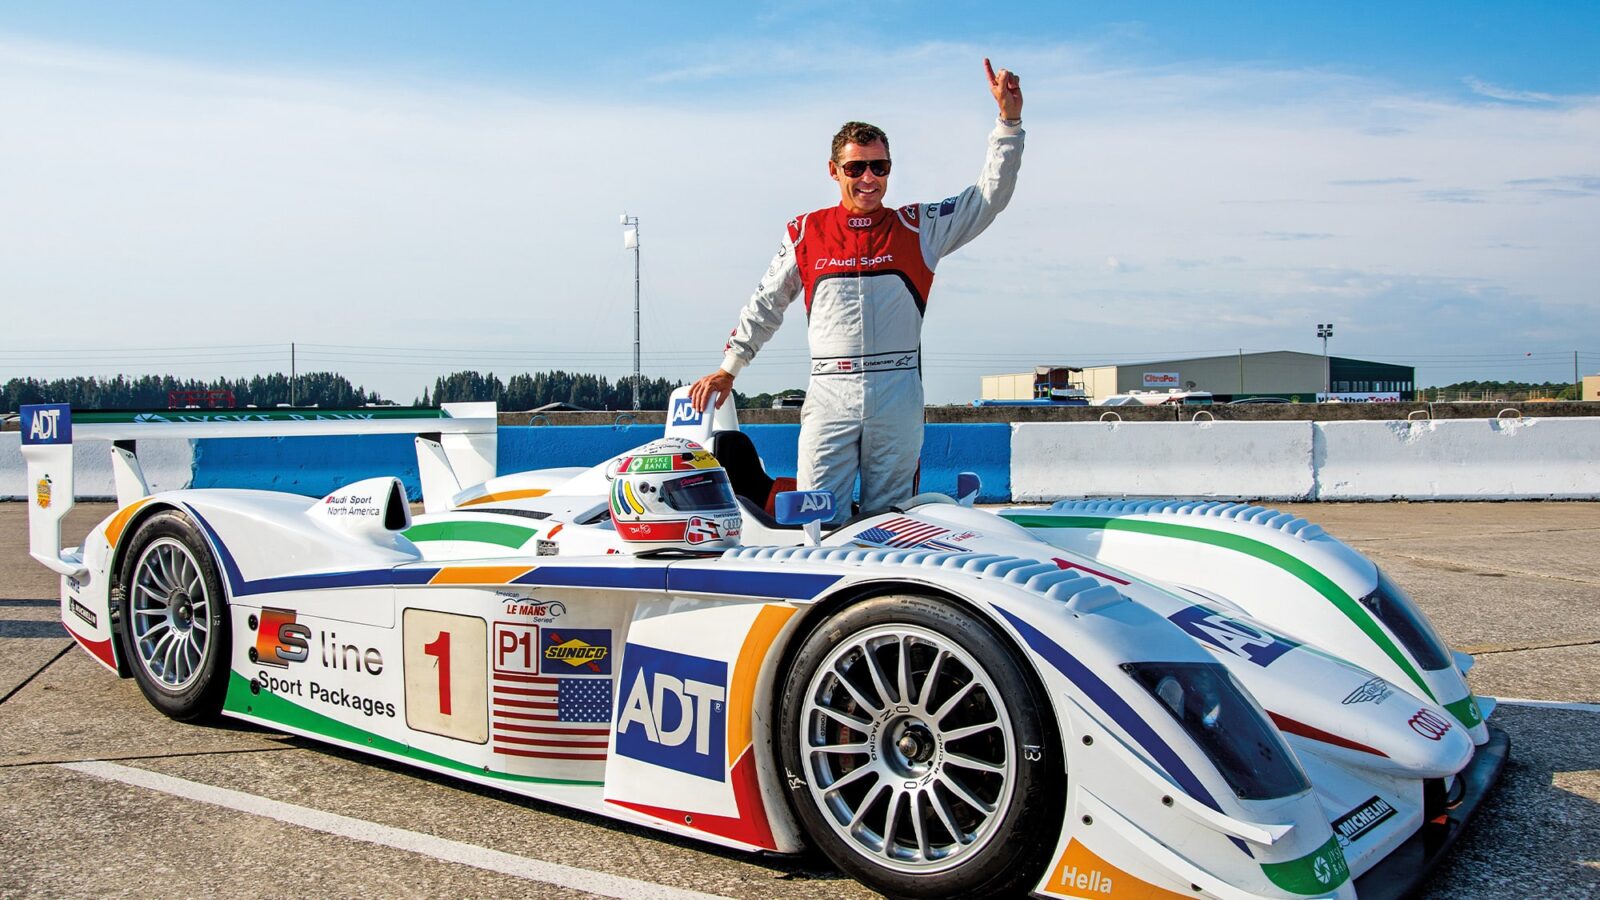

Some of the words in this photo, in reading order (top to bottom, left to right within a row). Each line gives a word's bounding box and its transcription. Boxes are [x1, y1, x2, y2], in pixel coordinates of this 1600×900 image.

[828, 258, 856, 266] Audi
[860, 254, 893, 267] Sport
[30, 409, 60, 440] ADT
[644, 462, 668, 470] BANK
[328, 507, 347, 515] North
[348, 507, 380, 515] America
[330, 496, 347, 504] Audi
[350, 496, 372, 506] Sport
[800, 492, 832, 513] ADT
[496, 590, 520, 598] American
[507, 604, 518, 614] LE
[519, 605, 546, 616] MANS
[533, 616, 552, 624] Series
[321, 630, 383, 676] line
[499, 630, 531, 668] P1
[547, 647, 605, 659] SUNOCO
[424, 631, 452, 715] 1
[258, 670, 303, 697] Sport
[310, 681, 396, 717] Packages
[617, 666, 725, 756] ADT
[1338, 799, 1391, 837] MICHELIN
[1061, 865, 1112, 893] Hella
